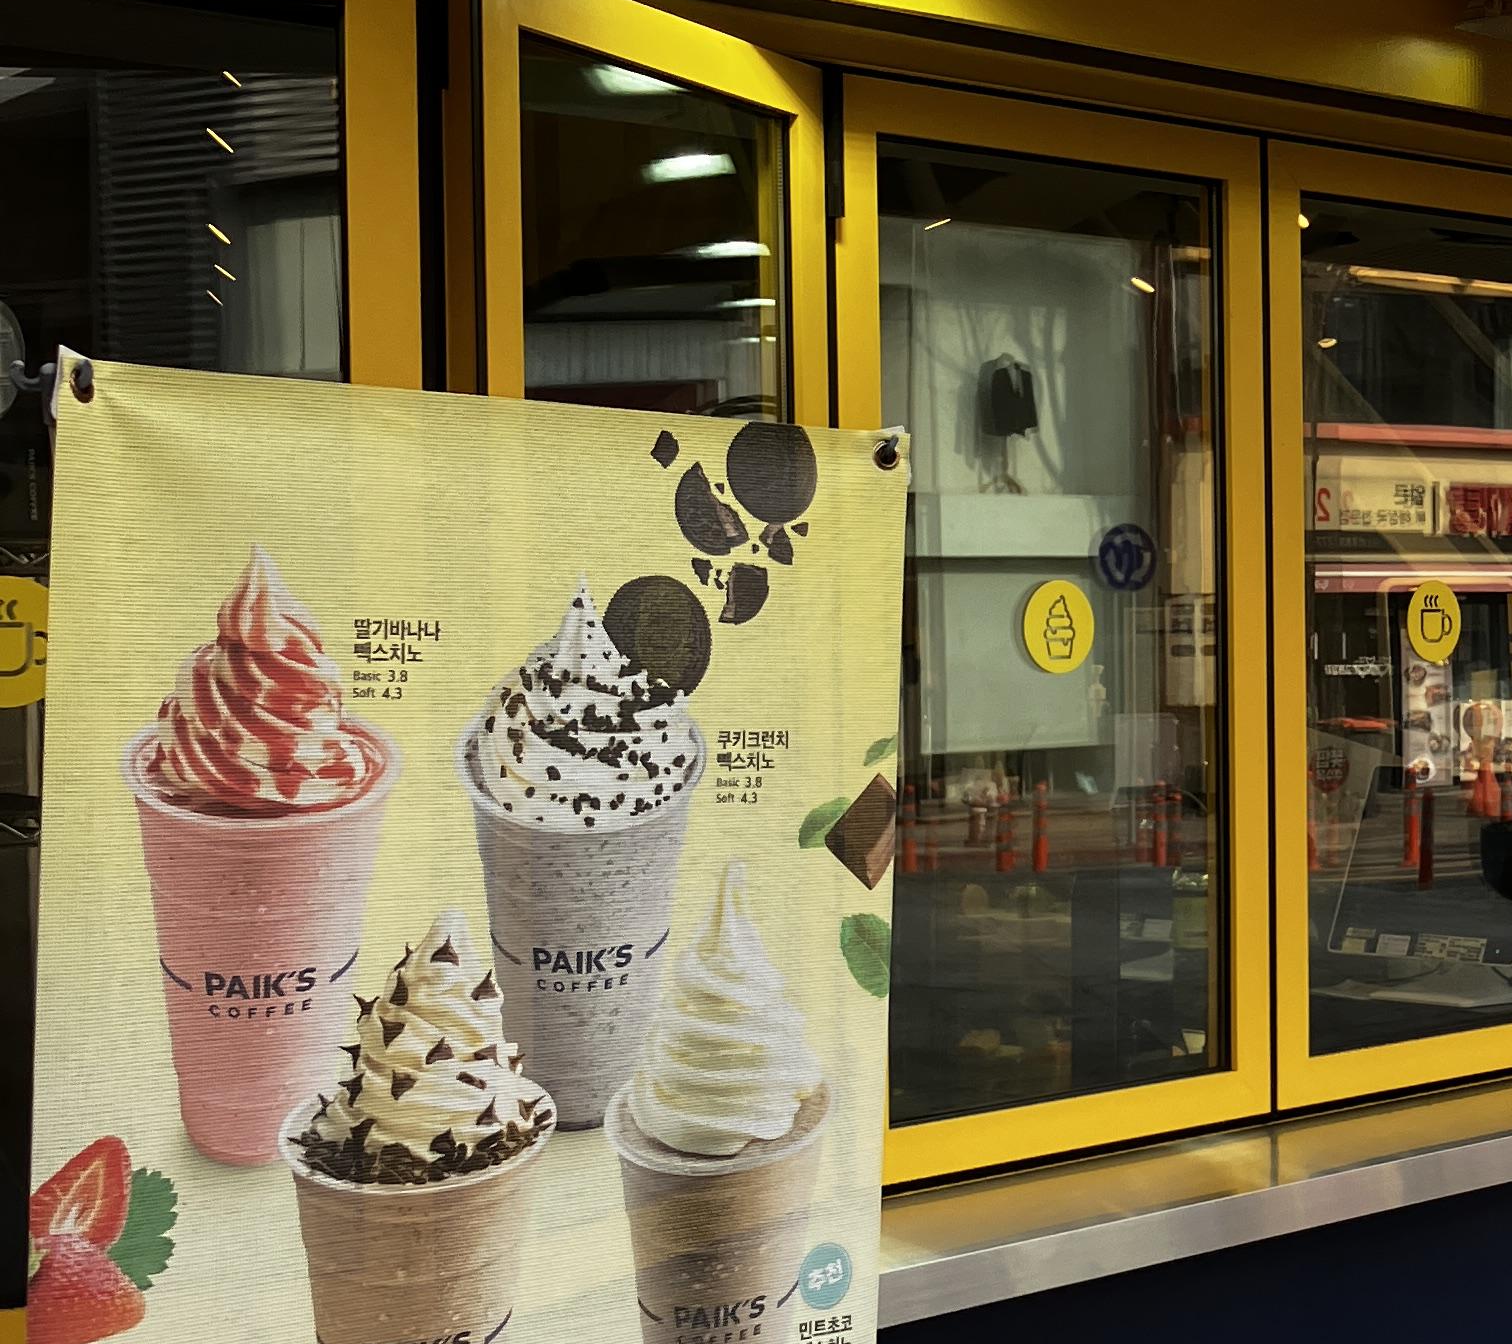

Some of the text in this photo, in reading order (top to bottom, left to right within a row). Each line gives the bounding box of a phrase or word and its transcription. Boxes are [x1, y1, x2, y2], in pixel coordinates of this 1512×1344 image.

[353, 618, 442, 642] 딸기바나나
[352, 669, 408, 683] Basic 3.8
[352, 686, 403, 700] Soft 4.3
[717, 730, 790, 750] 쿠키크런치
[716, 776, 763, 789] Basic 3.8
[715, 792, 758, 804] Soft 4.3
[532, 943, 635, 975] PAIK'S
[204, 966, 317, 1000] PAIK'S
[535, 973, 630, 993] COFFEE
[207, 997, 313, 1020] COFFEE
[673, 1294, 768, 1330] PAIK'S
[798, 1314, 853, 1341] 민트초코
